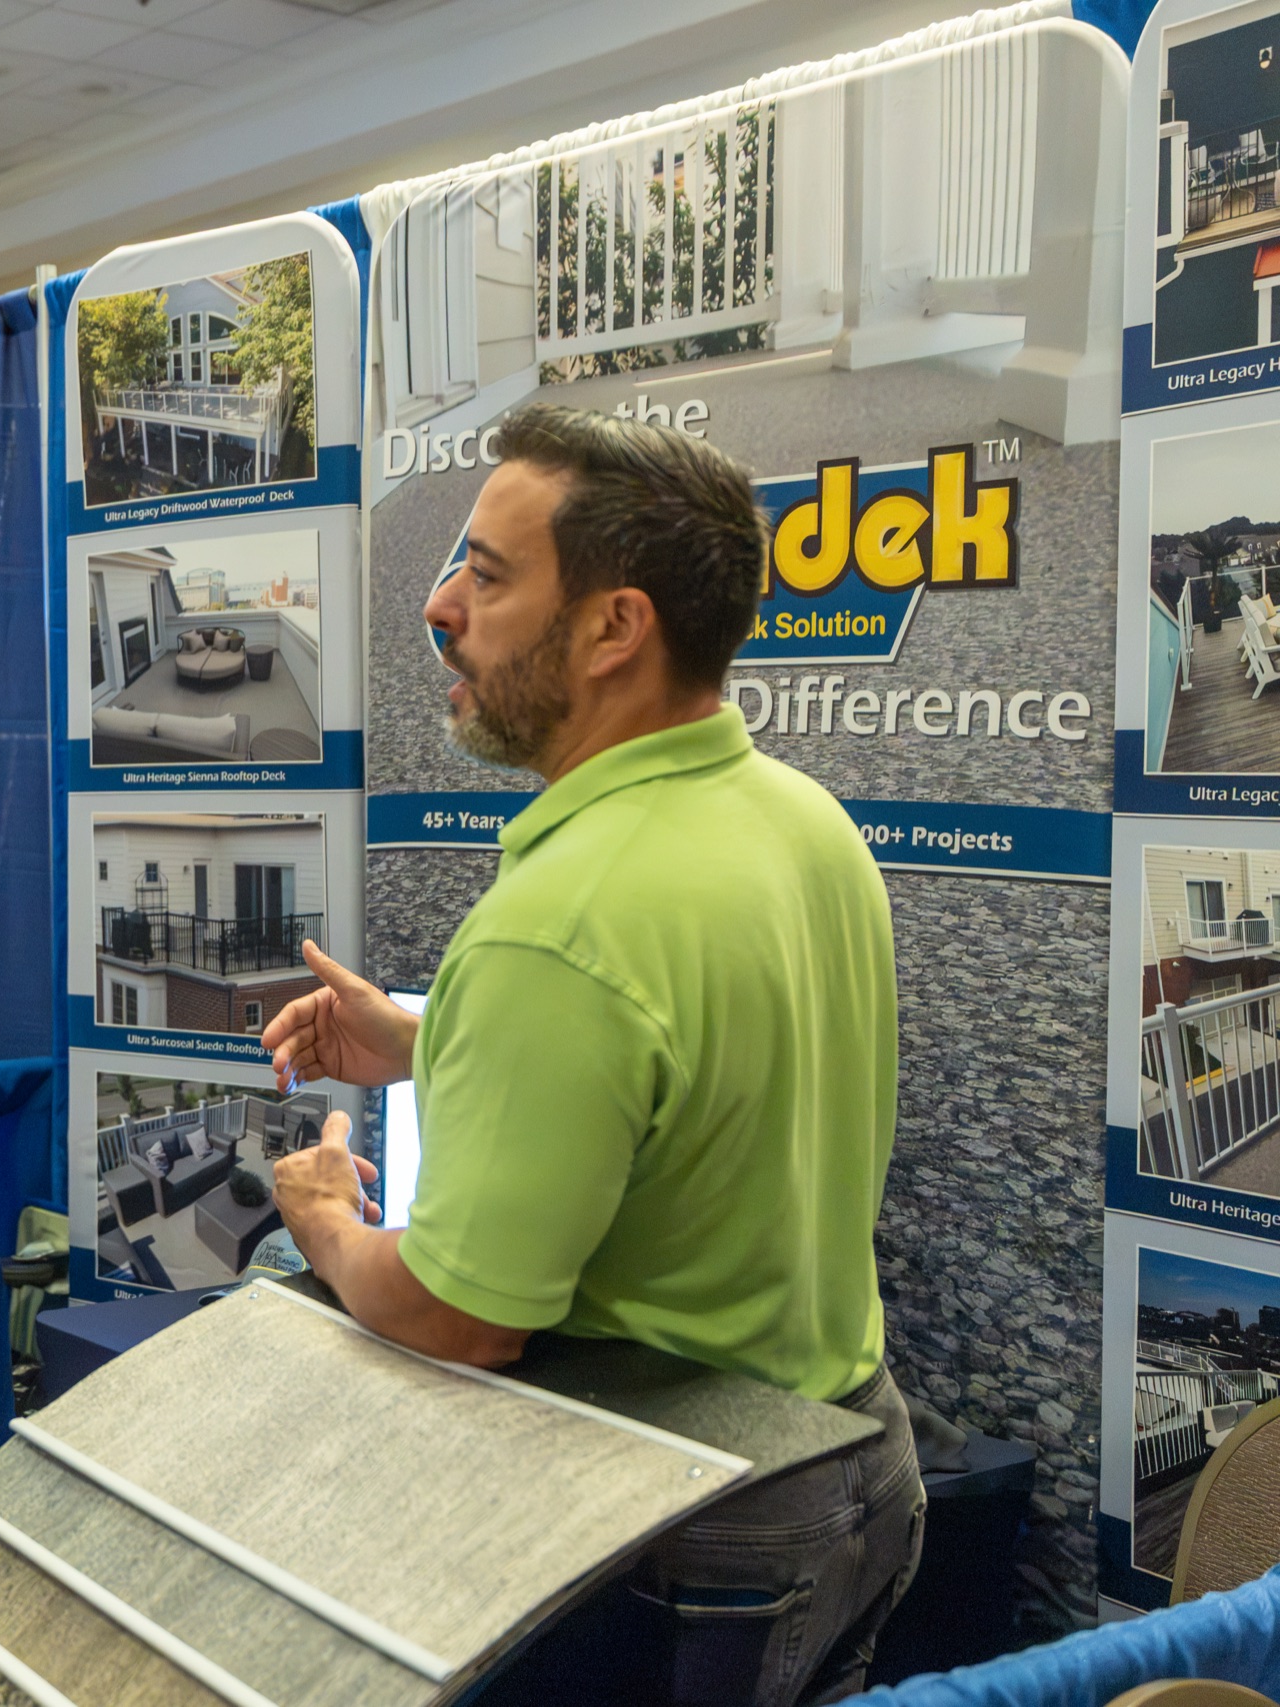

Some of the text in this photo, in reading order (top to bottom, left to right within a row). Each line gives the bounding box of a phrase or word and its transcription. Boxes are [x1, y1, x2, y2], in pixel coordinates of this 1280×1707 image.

[1168, 374, 1205, 390] Ultra
[1209, 362, 1266, 384] Legacy
[383, 425, 504, 479] Disco
[104, 489, 295, 523] Ultra Legacy Driftwood Waterproof Deck
[760, 443, 1019, 598] dek
[775, 610, 886, 639] Solution
[729, 675, 1092, 741] Difference
[123, 770, 286, 785] Ultra Heritage Sienna Rooftop Deck
[1189, 786, 1280, 806] Ultra Legac
[423, 811, 505, 829] 45+ Years
[911, 826, 1013, 855] Projects
[127, 1033, 149, 1045] Ultra
[151, 1036, 194, 1049] Surcoseal
[196, 1040, 224, 1051] Suede
[226, 1042, 265, 1057] Rooftop
[1170, 1191, 1280, 1228] Ultra Heritage
